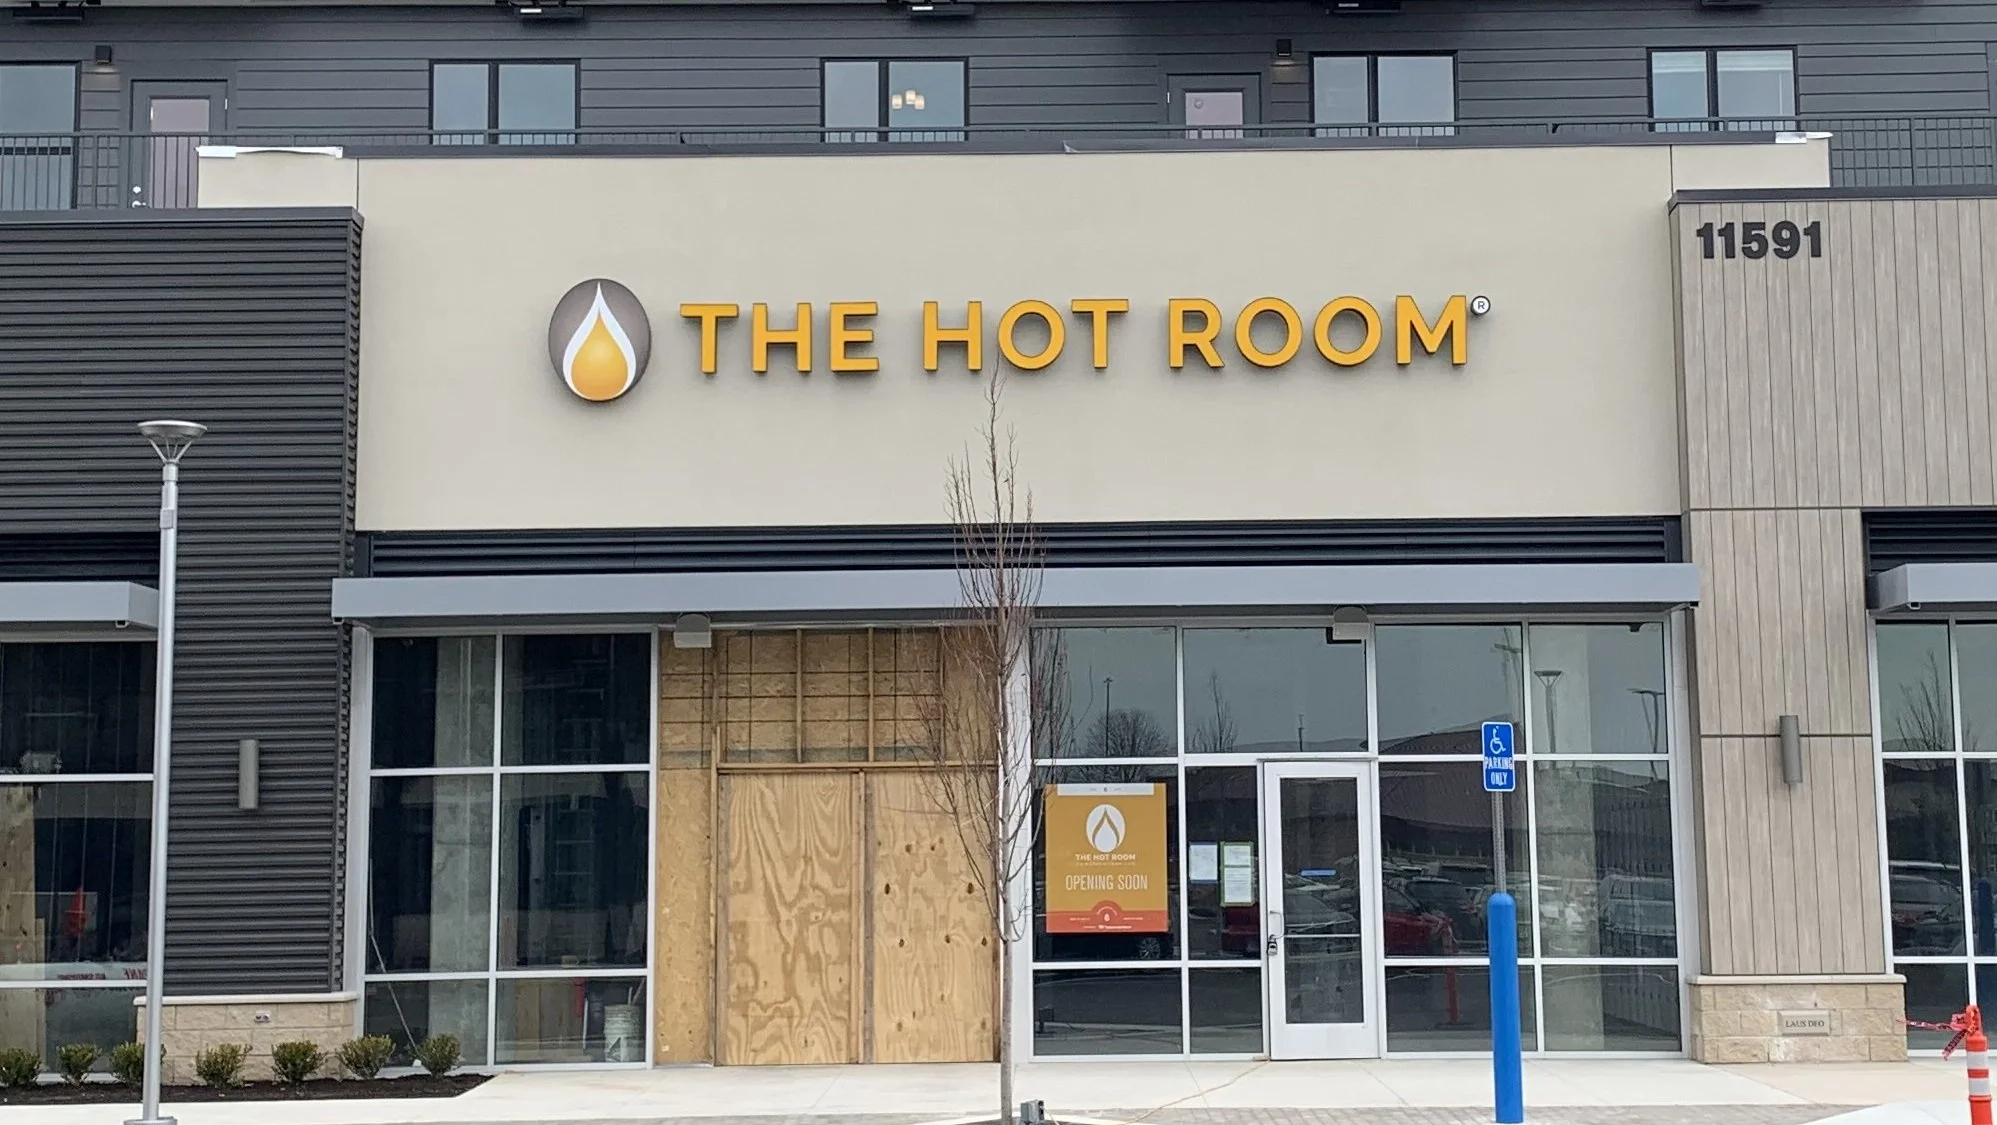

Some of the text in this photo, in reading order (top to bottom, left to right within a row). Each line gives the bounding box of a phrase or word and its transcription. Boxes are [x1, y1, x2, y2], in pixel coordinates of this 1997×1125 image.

[1696, 220, 1822, 260] 11591
[679, 301, 880, 374] THE
[922, 299, 1130, 371] HOT
[1483, 757, 1513, 769] PARKING
[1490, 772, 1507, 785] ONLY
[1111, 853, 1136, 861] ROOM
[1065, 874, 1148, 890] OPENING SOON
